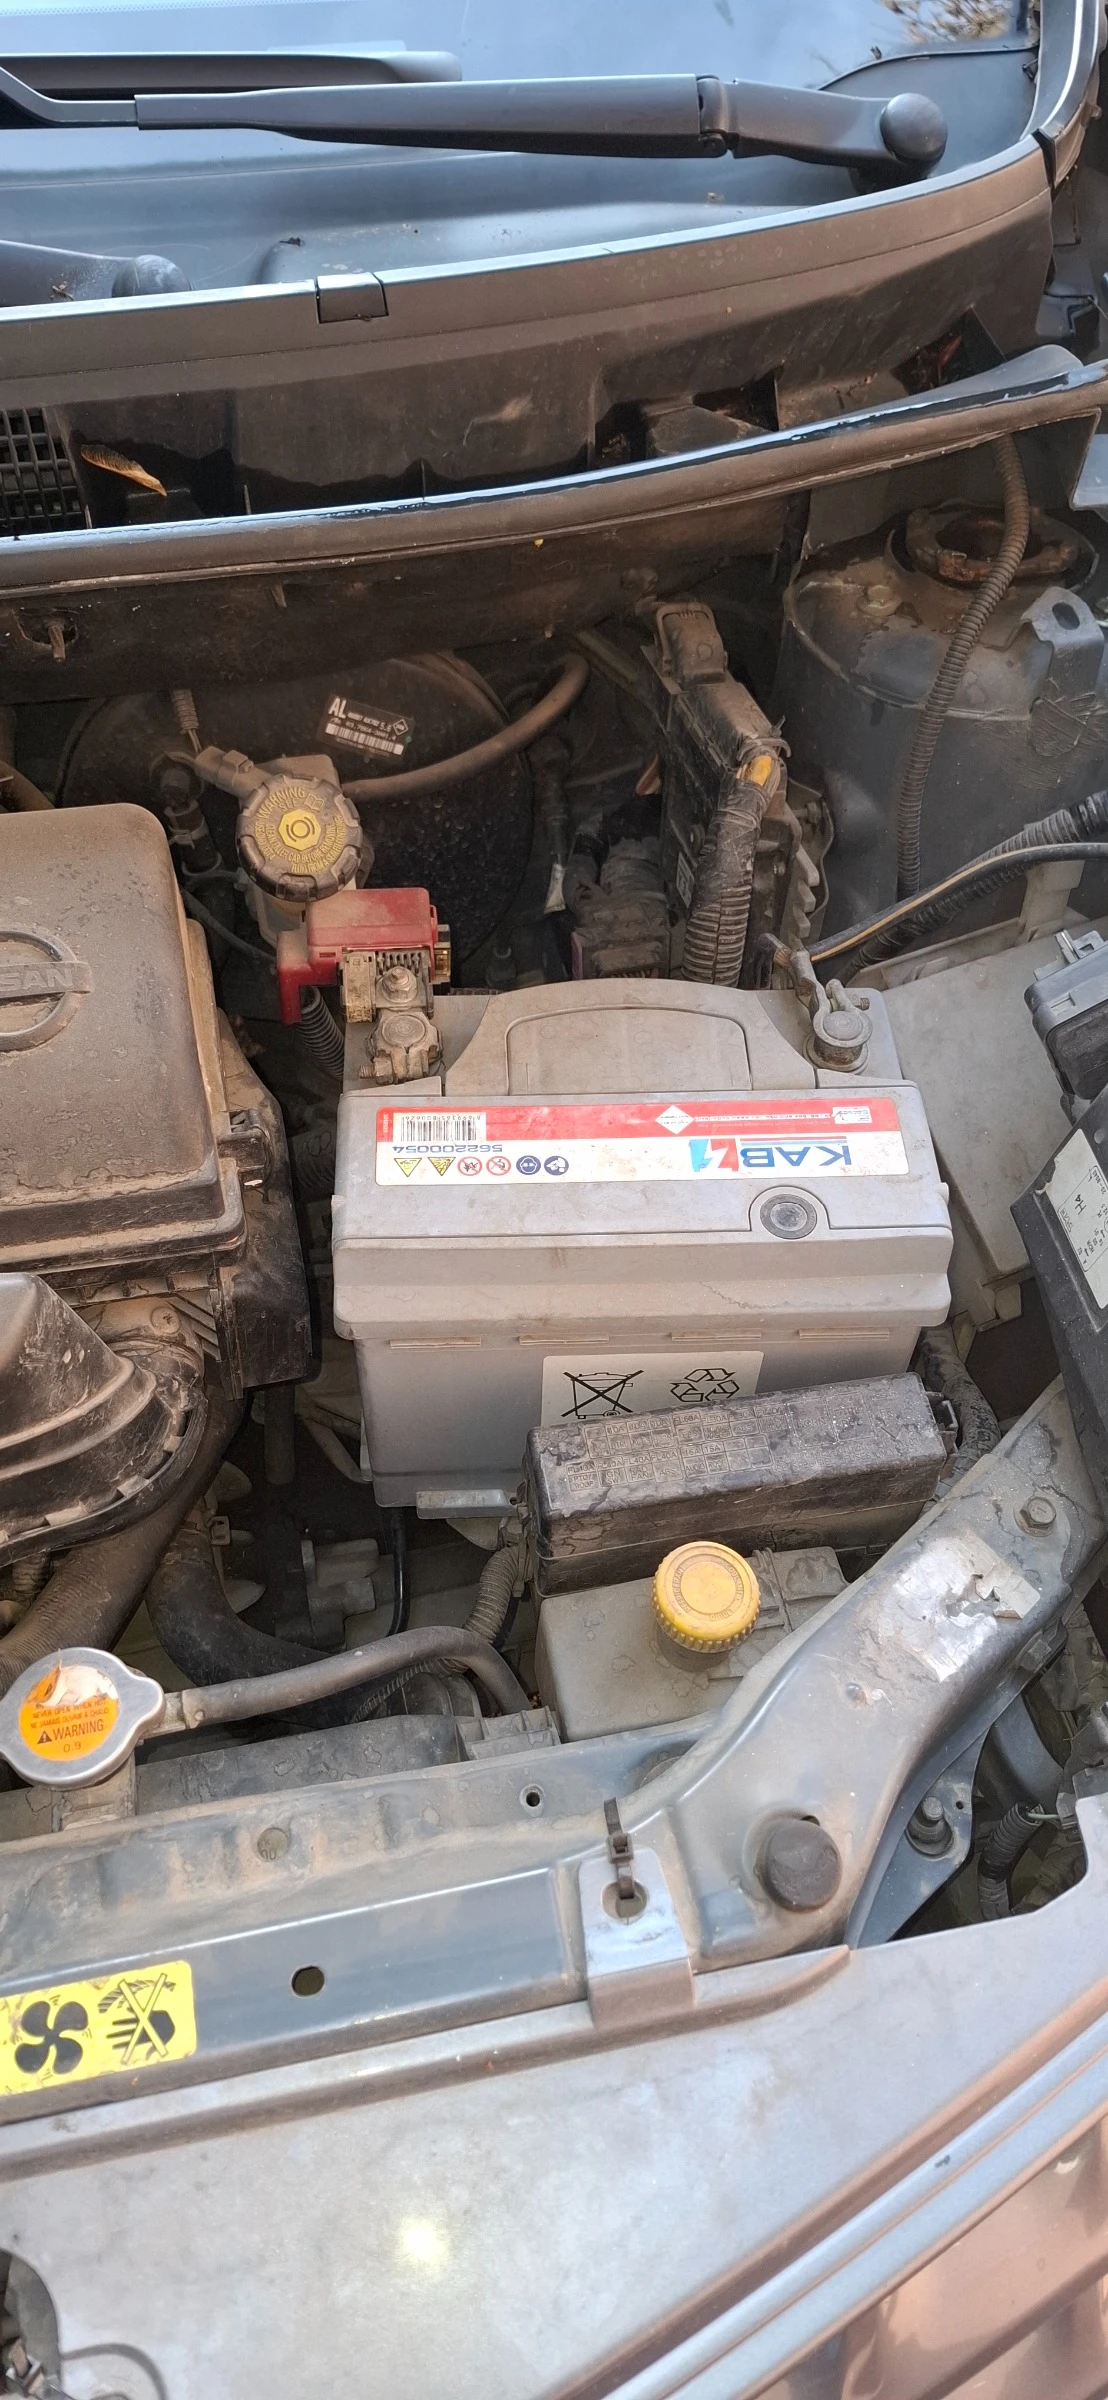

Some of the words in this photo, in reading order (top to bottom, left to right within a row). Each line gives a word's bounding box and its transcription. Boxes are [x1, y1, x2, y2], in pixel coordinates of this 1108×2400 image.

[328, 697, 347, 719] AL
[256, 786, 306, 819] WARNING
[278, 798, 300, 812] SEE
[288, 852, 301, 863] CAP
[392, 1144, 503, 1153] 562200054
[1074, 1193, 1087, 1216] H4
[704, 1445, 720, 1453] 15A
[624, 1456, 650, 1467] FL40A
[651, 1451, 677, 1462] FL40A
[54, 1706, 71, 1716] OPEN
[53, 1718, 104, 1741] WARNING
[63, 1741, 82, 1753] 0.9
